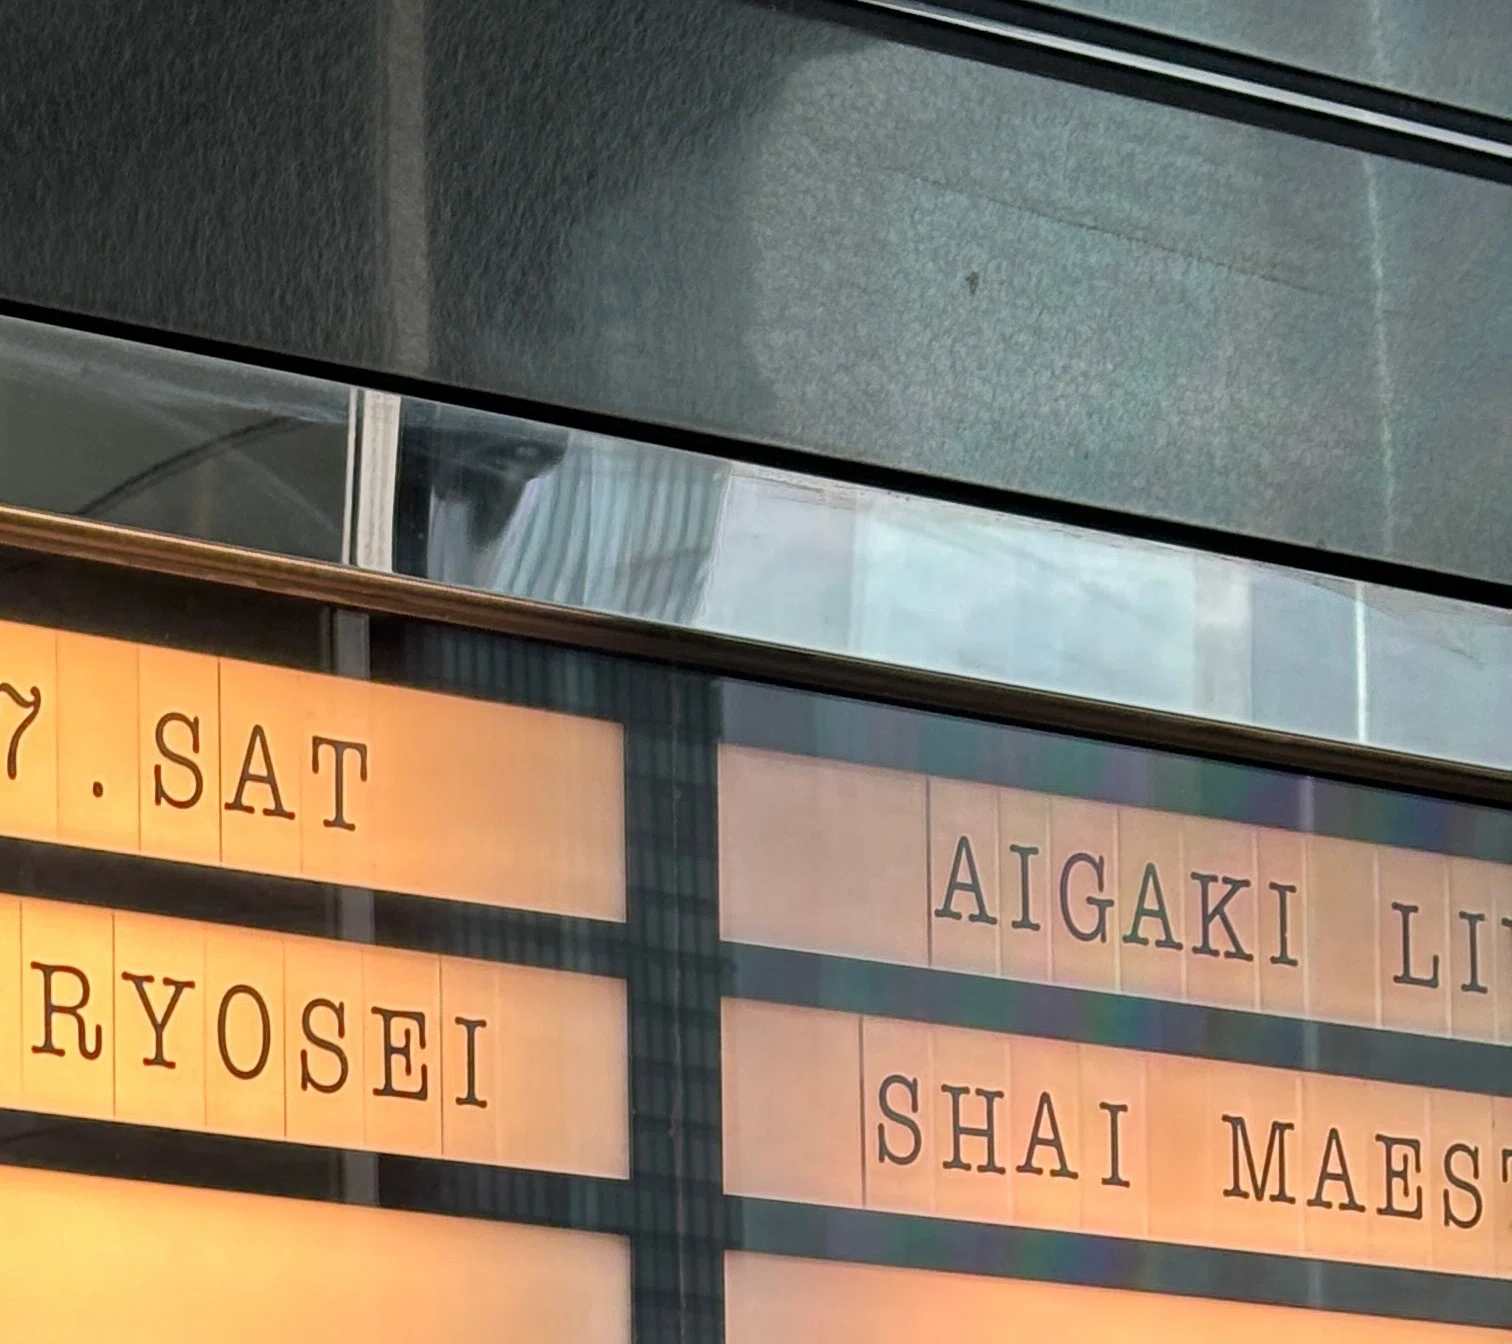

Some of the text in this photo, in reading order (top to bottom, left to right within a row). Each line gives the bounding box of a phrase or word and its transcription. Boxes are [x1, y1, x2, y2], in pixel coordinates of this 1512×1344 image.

[934, 835, 1512, 994] AIGAKI LI
[31, 961, 488, 1108] RYOSEI
[877, 1074, 1512, 1229] SHAI MAES
